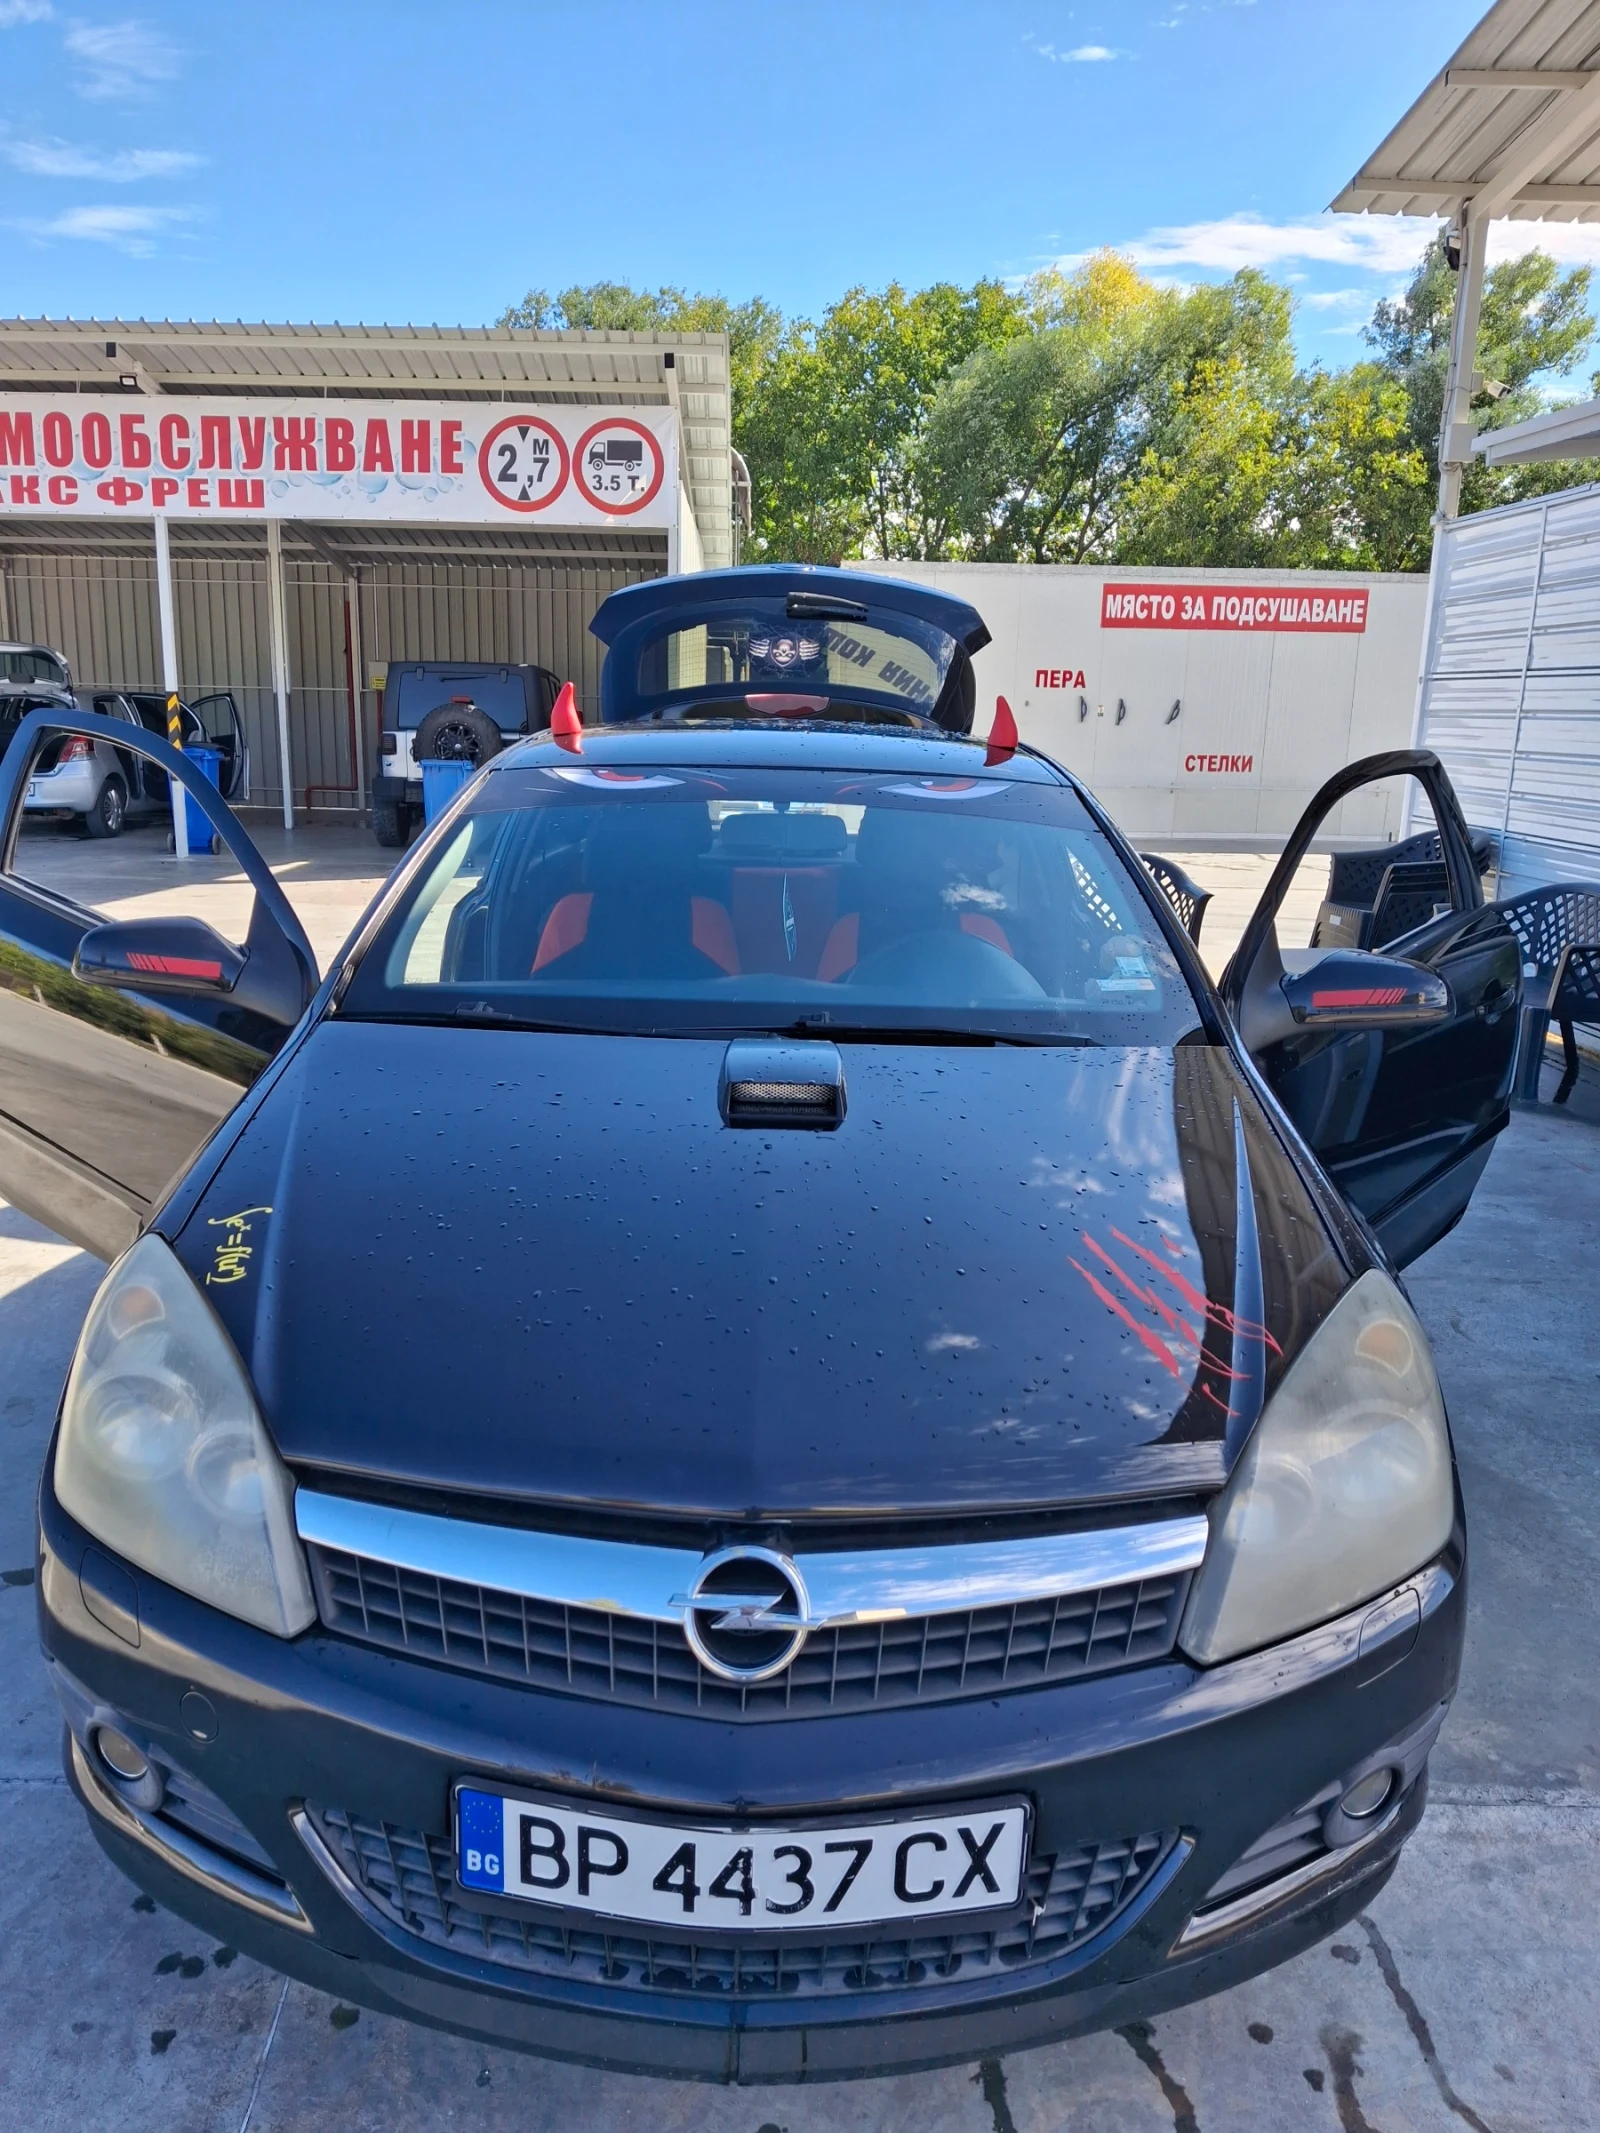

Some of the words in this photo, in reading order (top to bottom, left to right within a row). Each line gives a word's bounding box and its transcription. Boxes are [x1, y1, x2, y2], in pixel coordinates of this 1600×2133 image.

[0, 411, 465, 474] МООБСЛУЖВАНЕ
[0, 475, 80, 506] КС
[97, 477, 265, 509] ФРЕШ
[592, 474, 621, 491] 3.5
[1105, 594, 1176, 620] МЯСТО
[1181, 595, 1206, 621] ЗА
[1211, 596, 1365, 626] ПОДСУШАВАНЕ
[1035, 669, 1086, 689] ПЕРА
[1185, 754, 1253, 773] СТЕЛКИ
[467, 1848, 500, 1876] BG
[518, 1813, 629, 1896] BP
[652, 1838, 874, 1916] 4437
[893, 1821, 1006, 1904] CX
